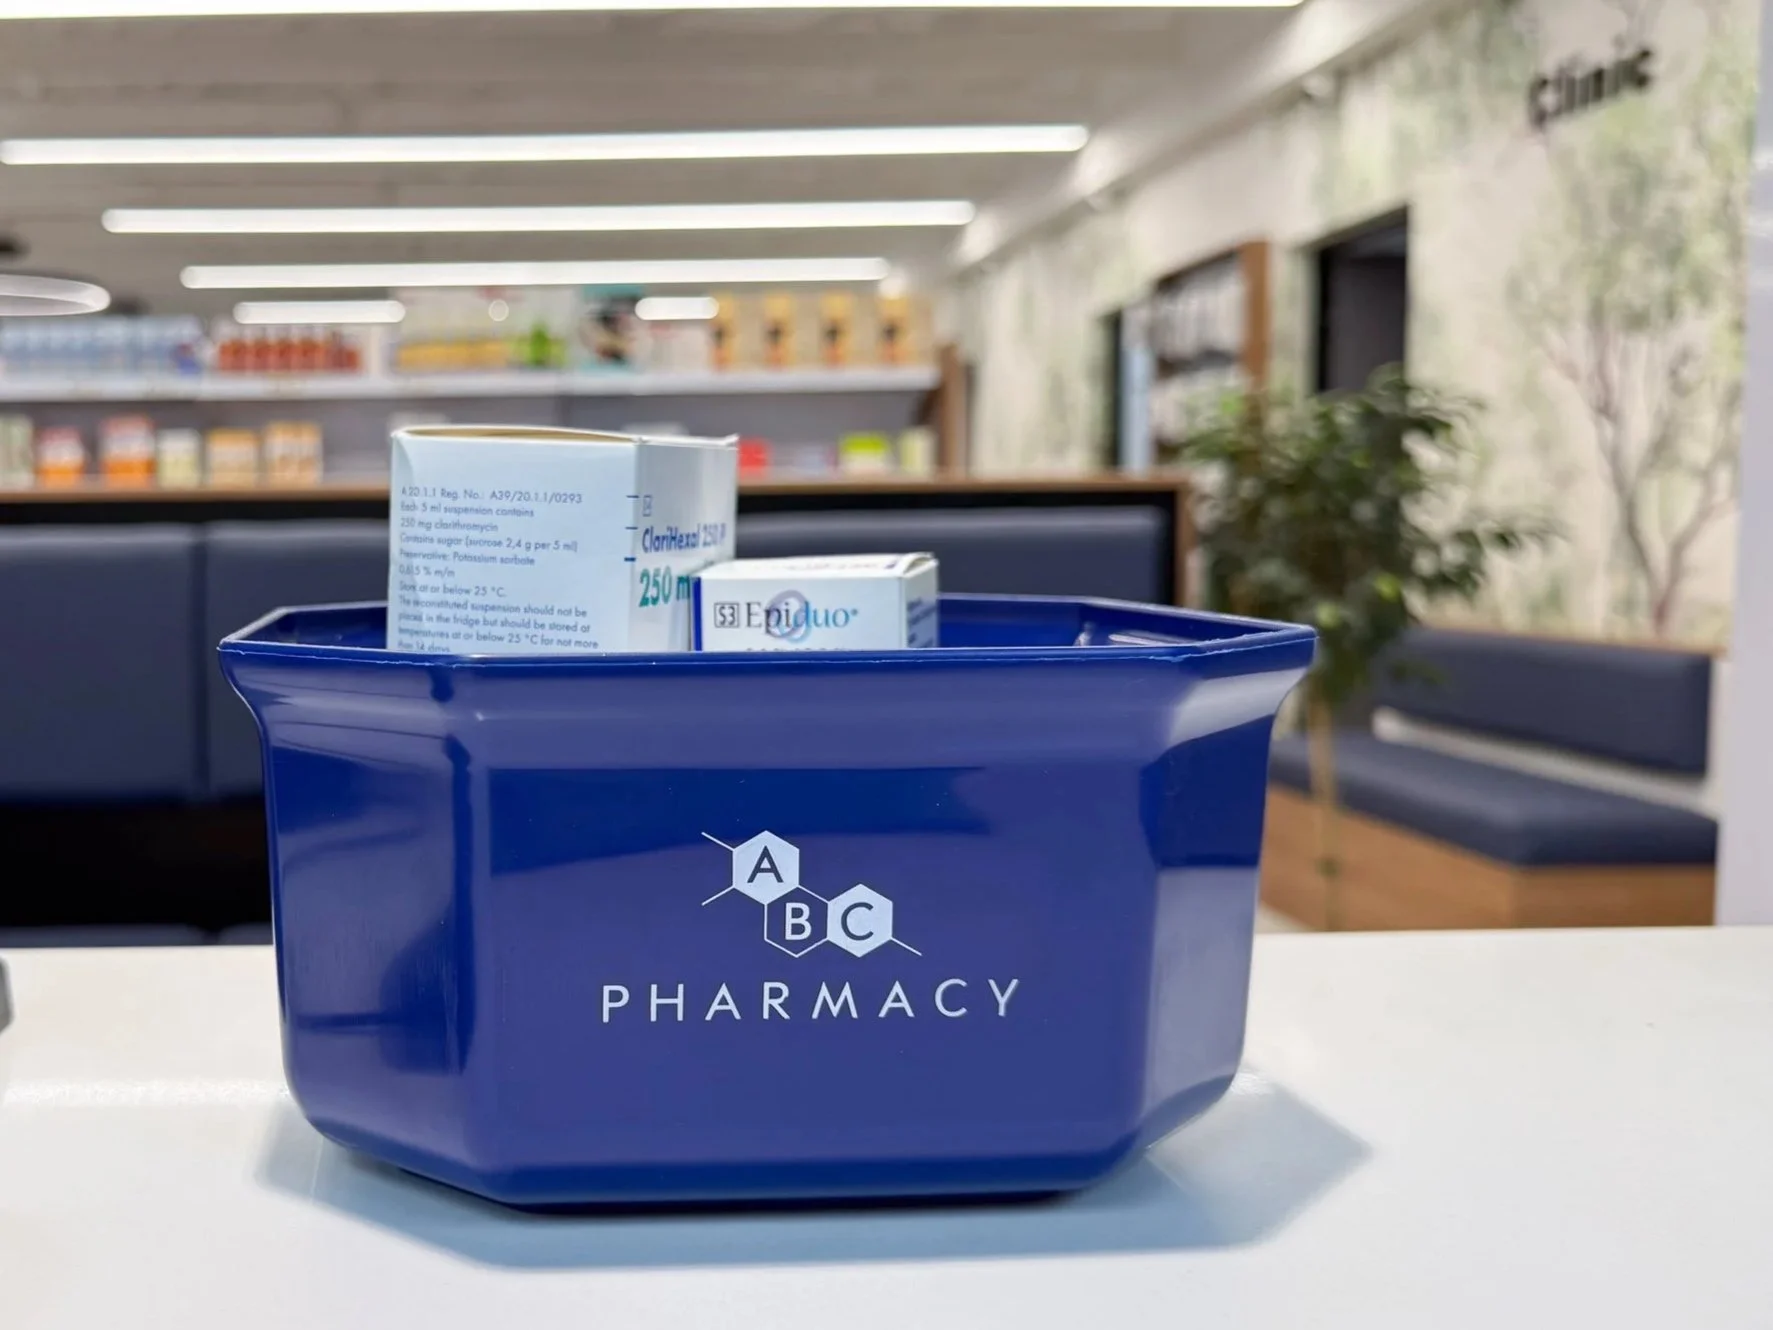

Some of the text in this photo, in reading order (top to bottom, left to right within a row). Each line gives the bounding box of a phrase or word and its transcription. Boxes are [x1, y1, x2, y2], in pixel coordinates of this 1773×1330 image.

[1529, 34, 1653, 127] Clinic
[440, 489, 459, 500] Reg.
[400, 501, 535, 518] Each 5 ml suspension contains
[400, 517, 499, 533] 250 mg clarithromycin
[399, 532, 578, 553] Contains sugar (sucrose 2,4 g per 5 ml)
[642, 523, 700, 553] ClariHexal
[399, 548, 536, 566] Preservative: Potassium sorbate
[423, 565, 432, 577] %
[434, 566, 455, 578] m/m
[398, 580, 416, 591] Store
[417, 582, 429, 592] at
[430, 584, 440, 593] or
[442, 583, 472, 596] below
[474, 585, 488, 596] 25
[639, 565, 690, 608] 250 m
[398, 595, 588, 618] The reconstituted suspension should not be
[717, 604, 737, 627] S3
[425, 612, 434, 623] in
[436, 612, 451, 624] the
[453, 612, 480, 628] fridge
[482, 614, 498, 627] but
[500, 616, 531, 630] should
[533, 617, 546, 630] be
[548, 619, 578, 633] stored
[580, 622, 591, 633] at
[397, 625, 599, 650] temperatures at or below 25 °C for not more
[602, 978, 1020, 1024] PHARMACY
